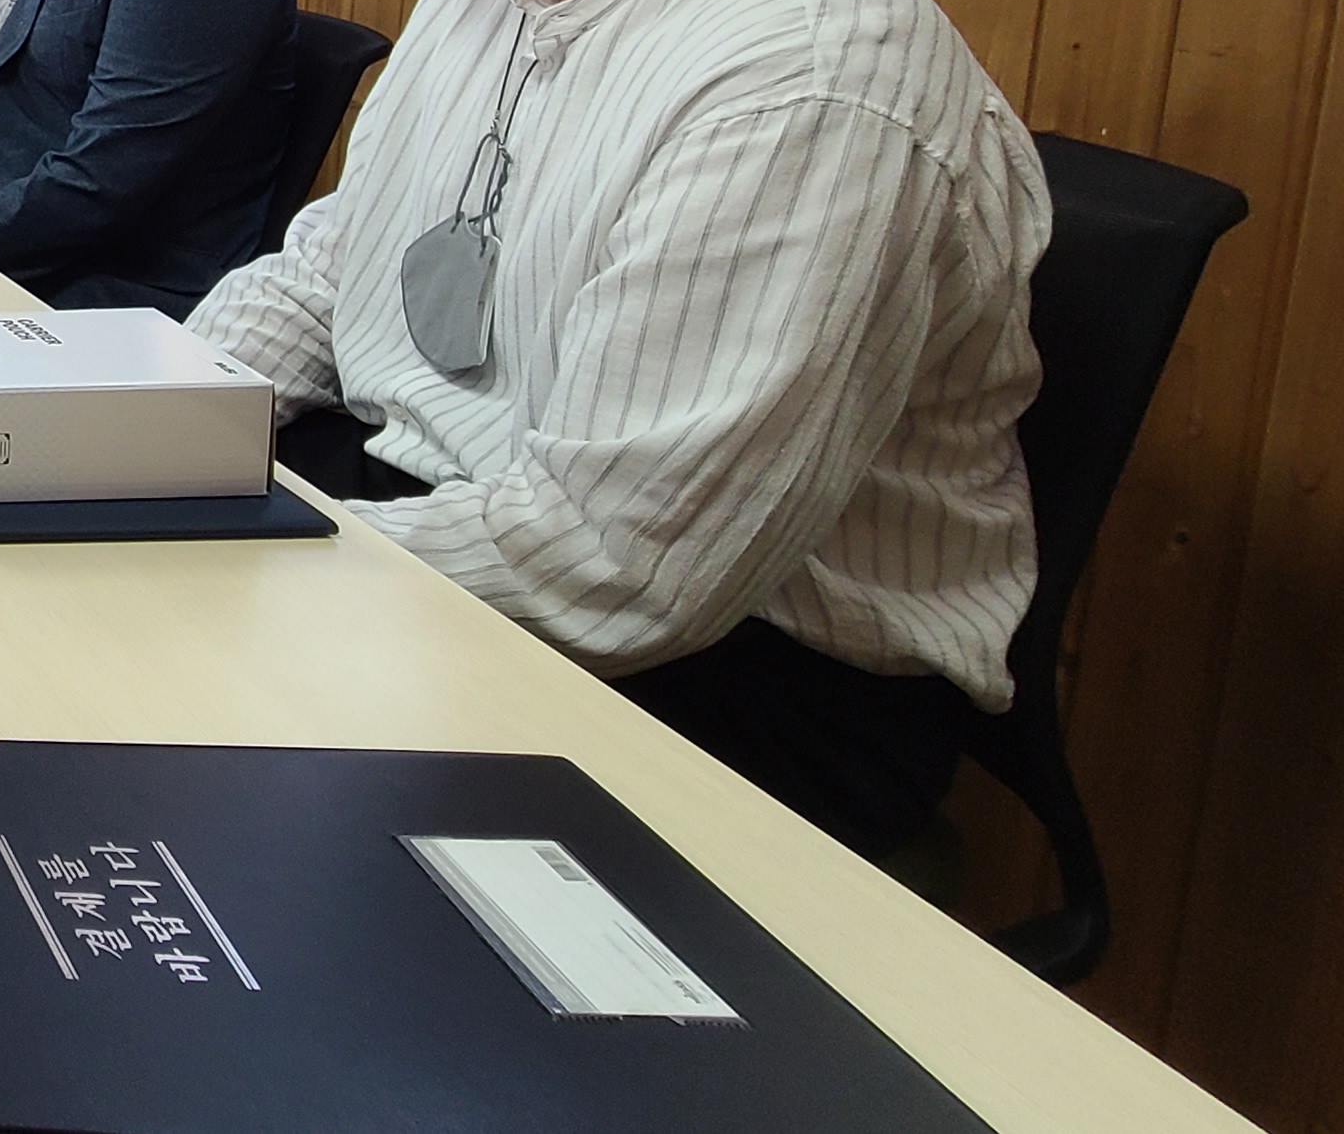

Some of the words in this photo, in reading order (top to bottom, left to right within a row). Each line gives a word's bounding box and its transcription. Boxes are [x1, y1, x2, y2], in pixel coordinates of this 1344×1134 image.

[17, 319, 63, 345] CARRIER
[37, 853, 133, 960] 결재를
[89, 841, 211, 984] 바랍니다
